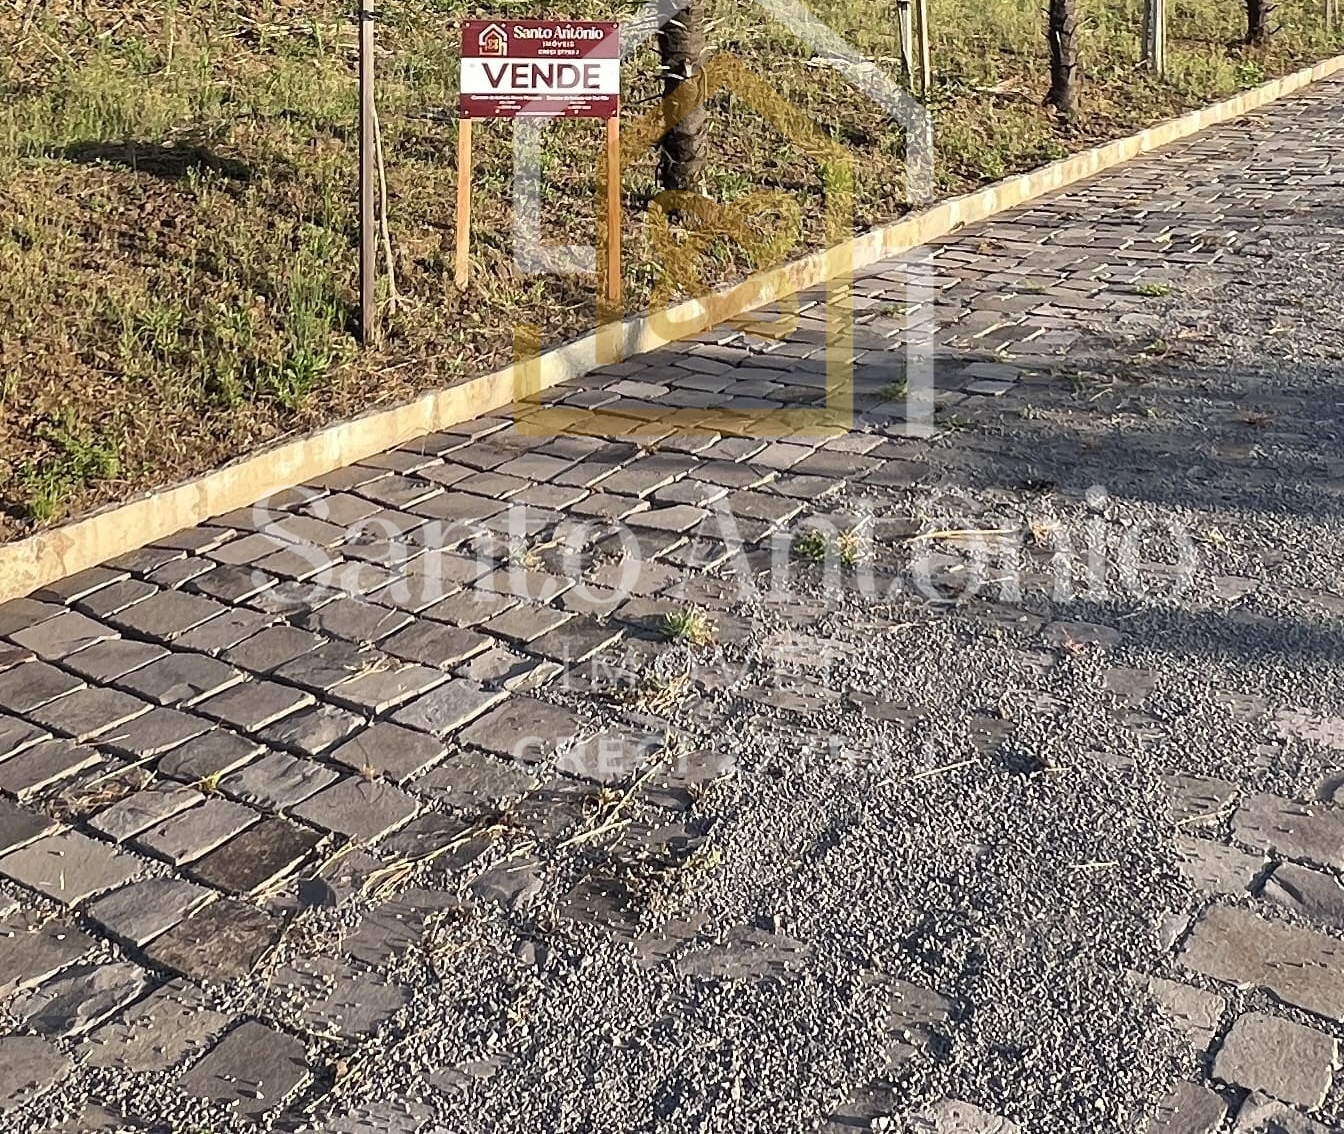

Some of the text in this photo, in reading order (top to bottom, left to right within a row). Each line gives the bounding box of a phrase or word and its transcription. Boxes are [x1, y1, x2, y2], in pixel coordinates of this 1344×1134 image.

[513, 23, 604, 40] Santo Antônio
[542, 40, 575, 48] IMÓVEIS
[482, 63, 601, 89] VENDE
